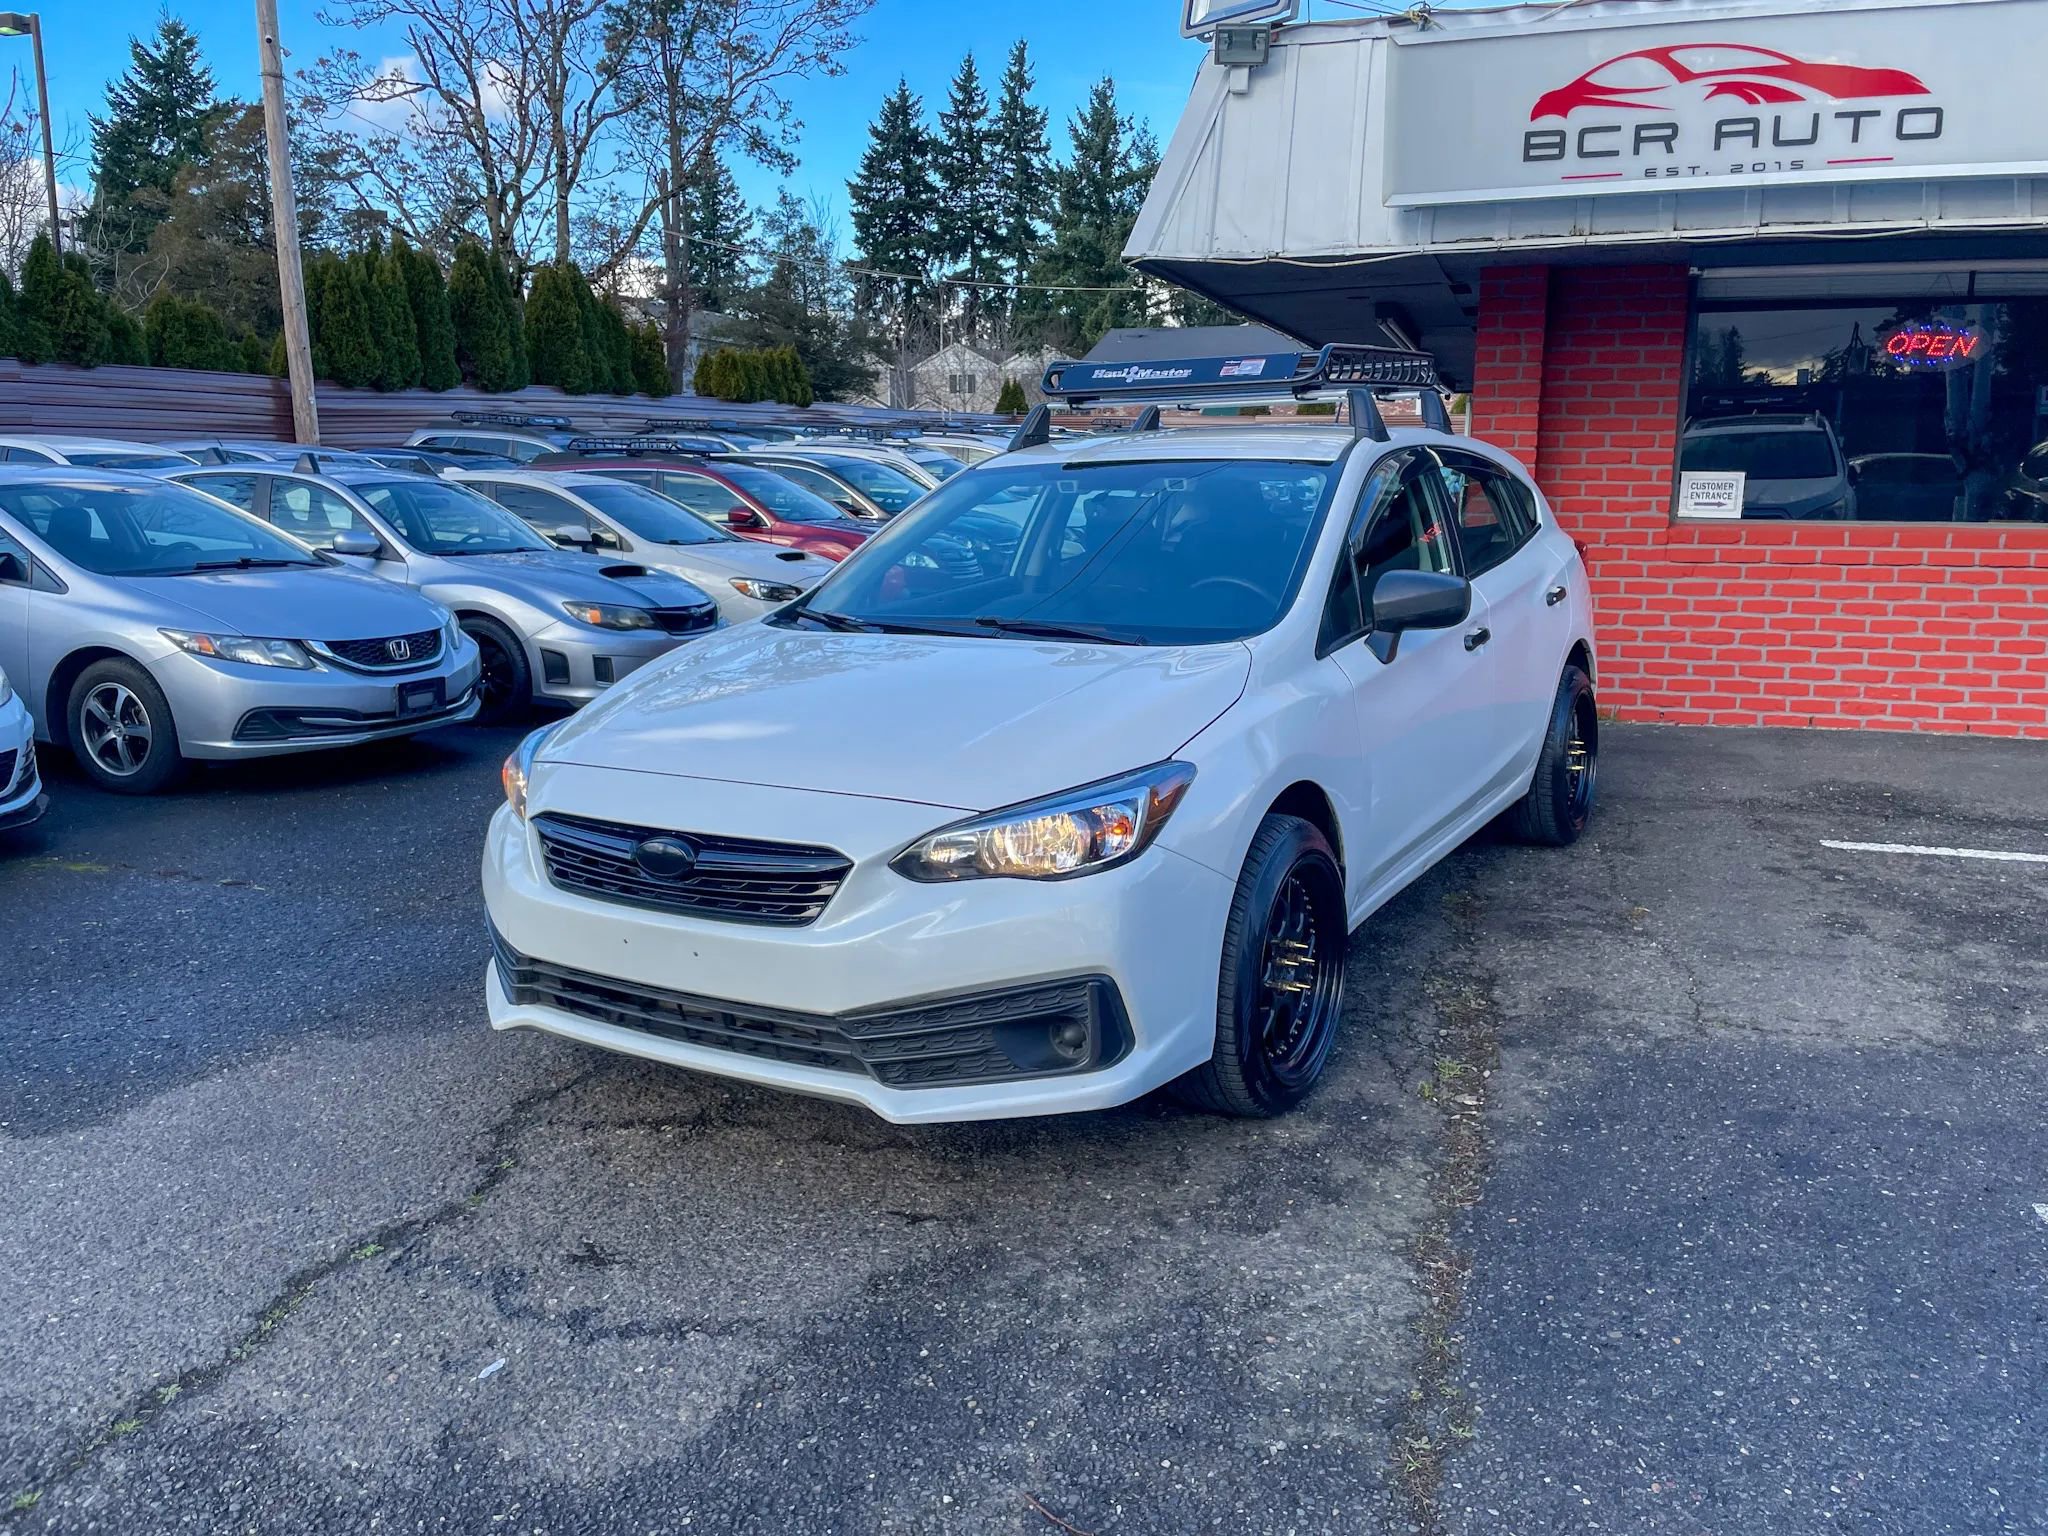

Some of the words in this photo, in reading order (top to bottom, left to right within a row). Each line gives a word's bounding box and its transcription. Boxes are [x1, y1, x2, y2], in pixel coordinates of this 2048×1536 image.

[1522, 122, 1679, 163] BCR
[1713, 106, 1944, 151] AUTO
[1644, 165, 1709, 178] EST.
[1730, 159, 1805, 174] 2015
[1887, 332, 1978, 357] OPEN
[1690, 482, 1734, 491] CUSTOMER
[1690, 491, 1733, 500] ENTRANCE
